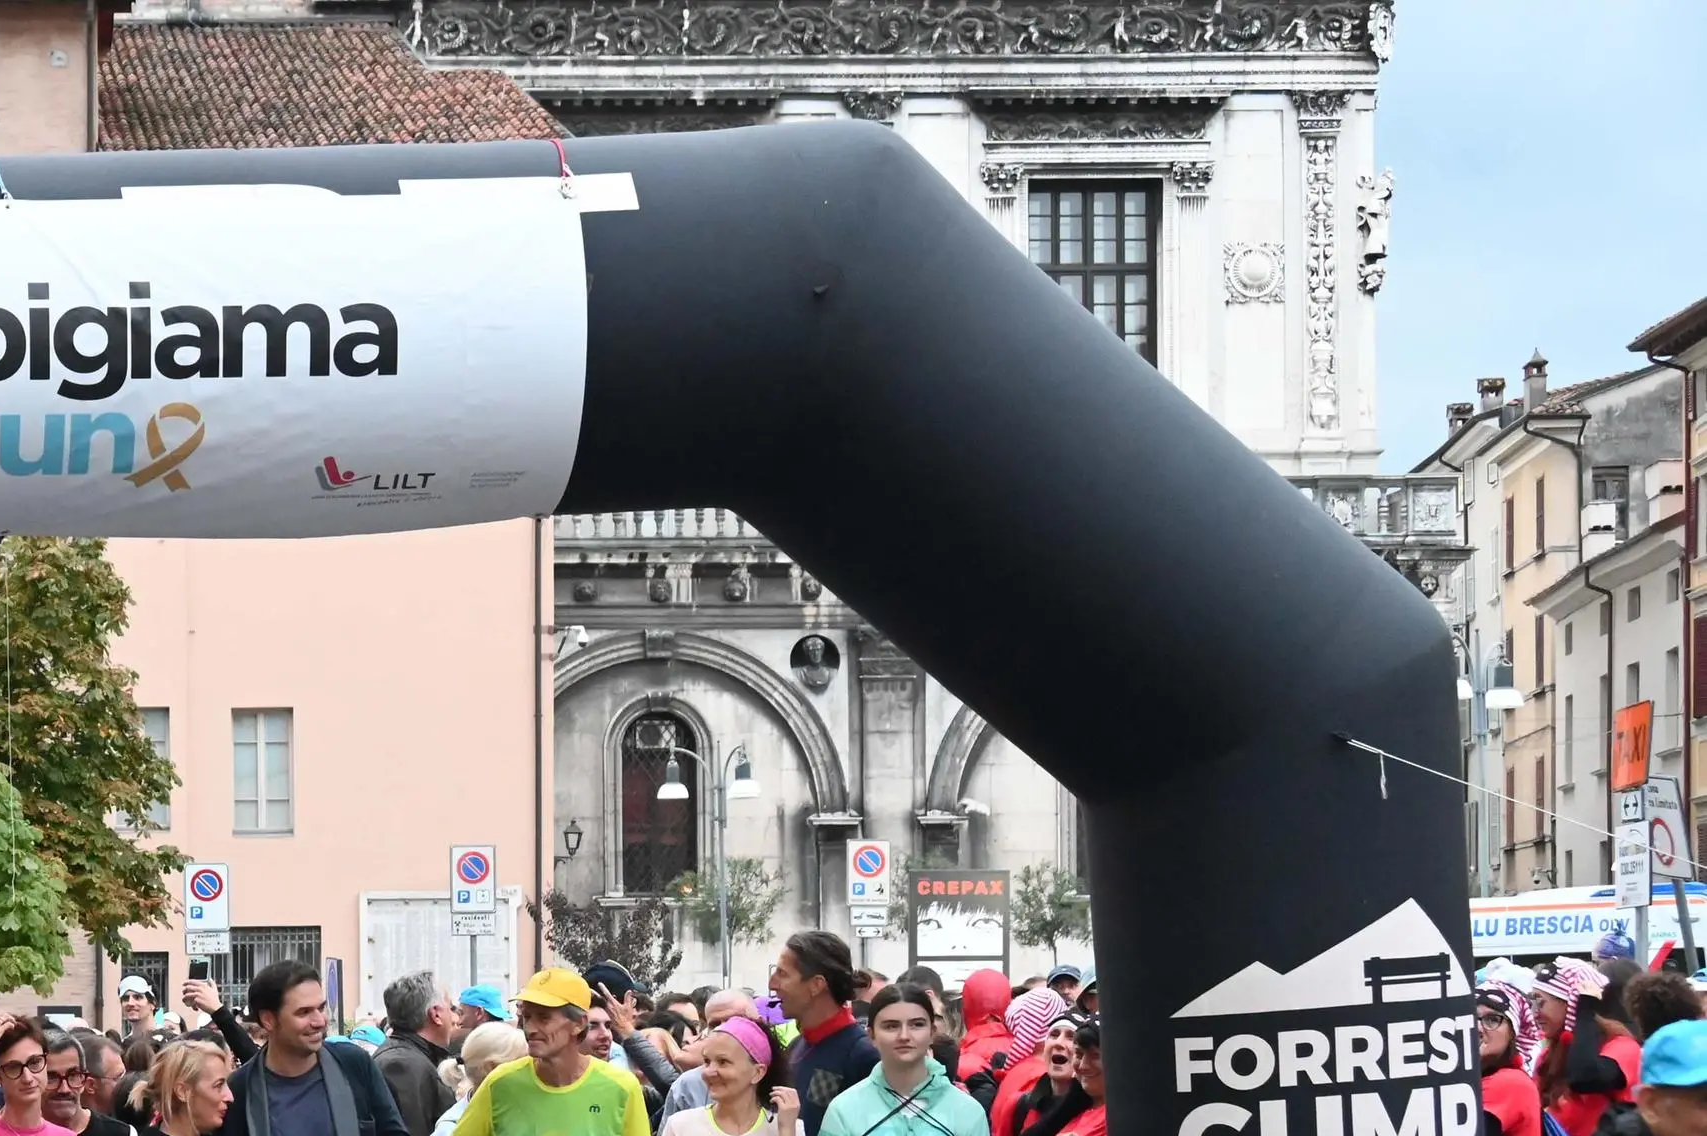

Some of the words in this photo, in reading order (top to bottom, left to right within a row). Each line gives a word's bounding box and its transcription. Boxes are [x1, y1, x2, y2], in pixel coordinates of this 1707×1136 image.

[372, 472, 436, 490] LILT
[1616, 722, 1648, 767] TAXI
[917, 880, 1005, 896] CREPAX
[1473, 917, 1499, 937] LU
[1504, 914, 1594, 936] BRESCIA
[1174, 1014, 1476, 1093] FORREST
